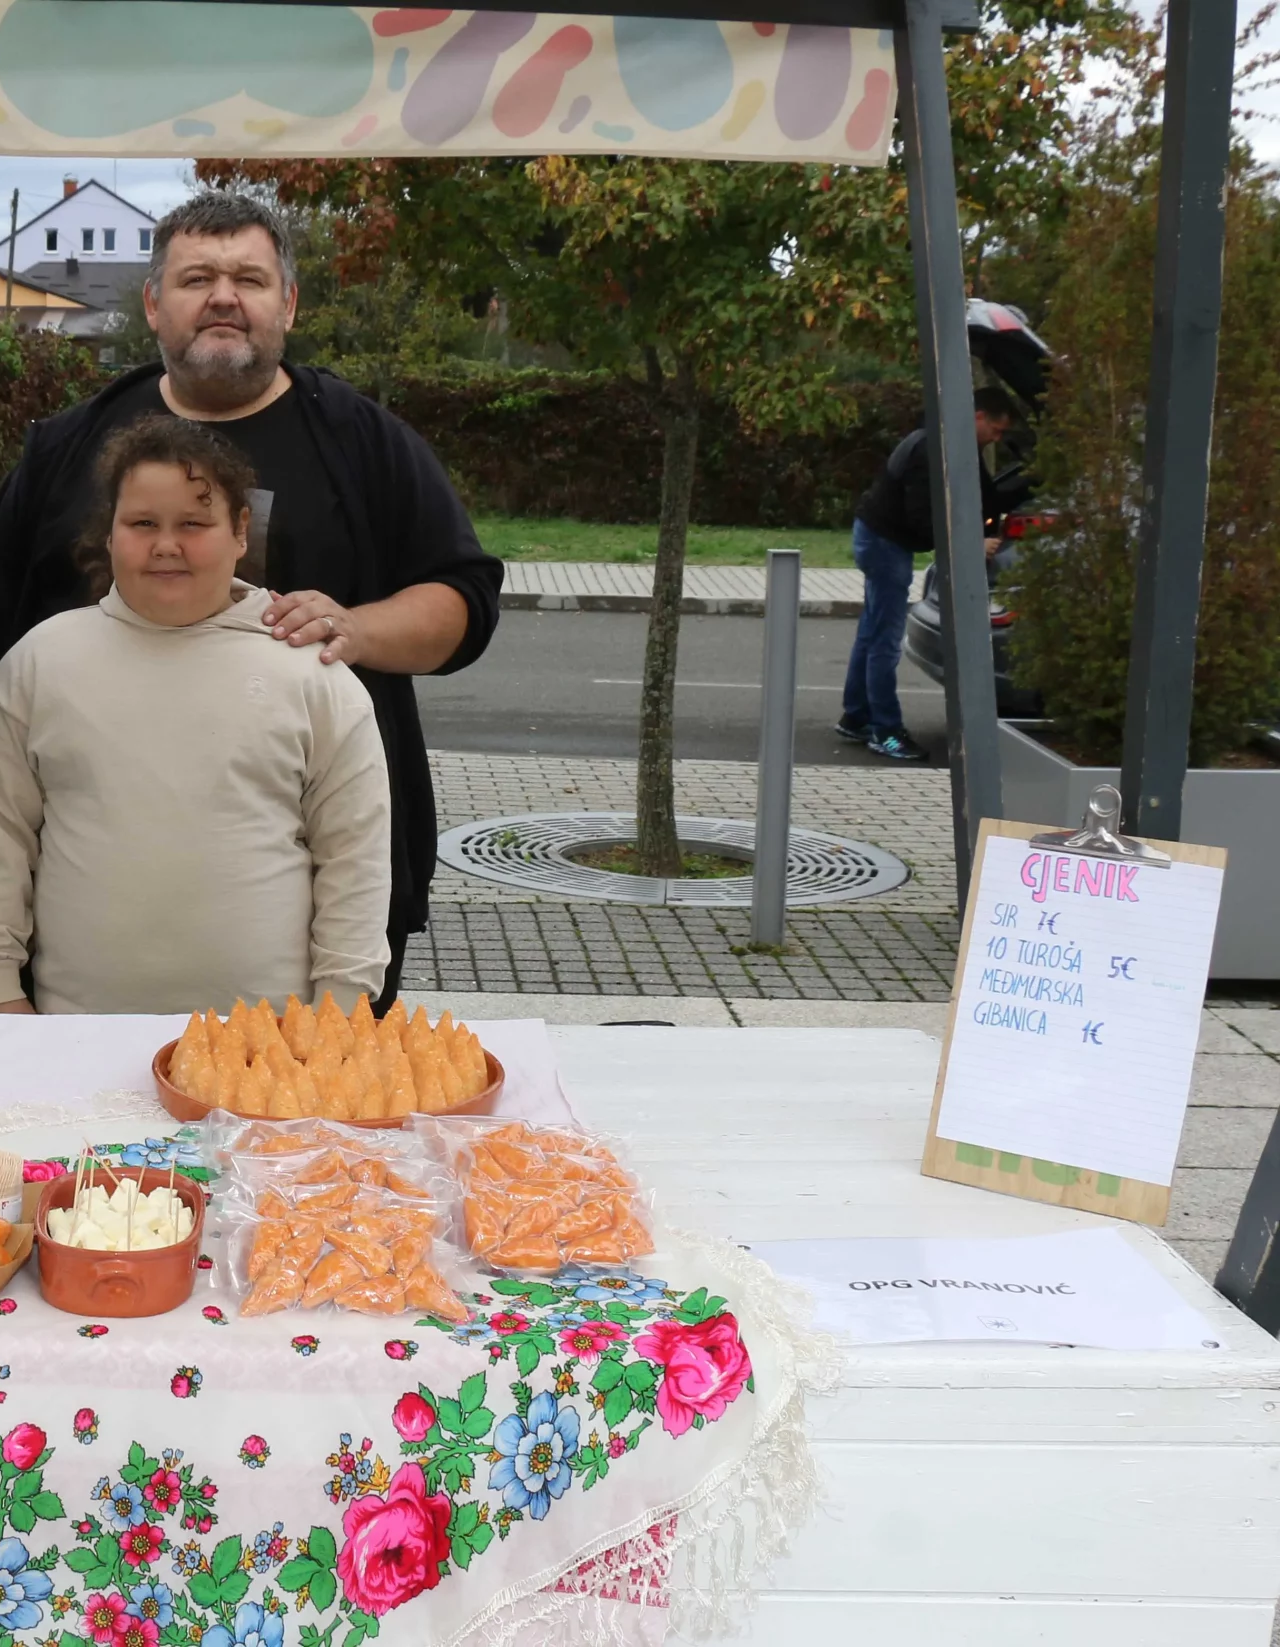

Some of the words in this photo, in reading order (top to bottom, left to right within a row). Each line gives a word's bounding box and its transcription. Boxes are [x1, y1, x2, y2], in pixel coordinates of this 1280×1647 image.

[1020, 852, 1140, 904] CJENIK
[990, 902, 1019, 928] SIR
[986, 936, 1008, 960] 10
[1018, 939, 1084, 974] TUROŠA
[1107, 955, 1138, 981] 5€
[978, 967, 1084, 1008] MEĐIMURSKA
[973, 1000, 1048, 1035] GIBANICA
[1081, 1019, 1105, 1045] 1€
[848, 1278, 913, 1291] OPG
[917, 1278, 1077, 1296] VRANOVIĆ
